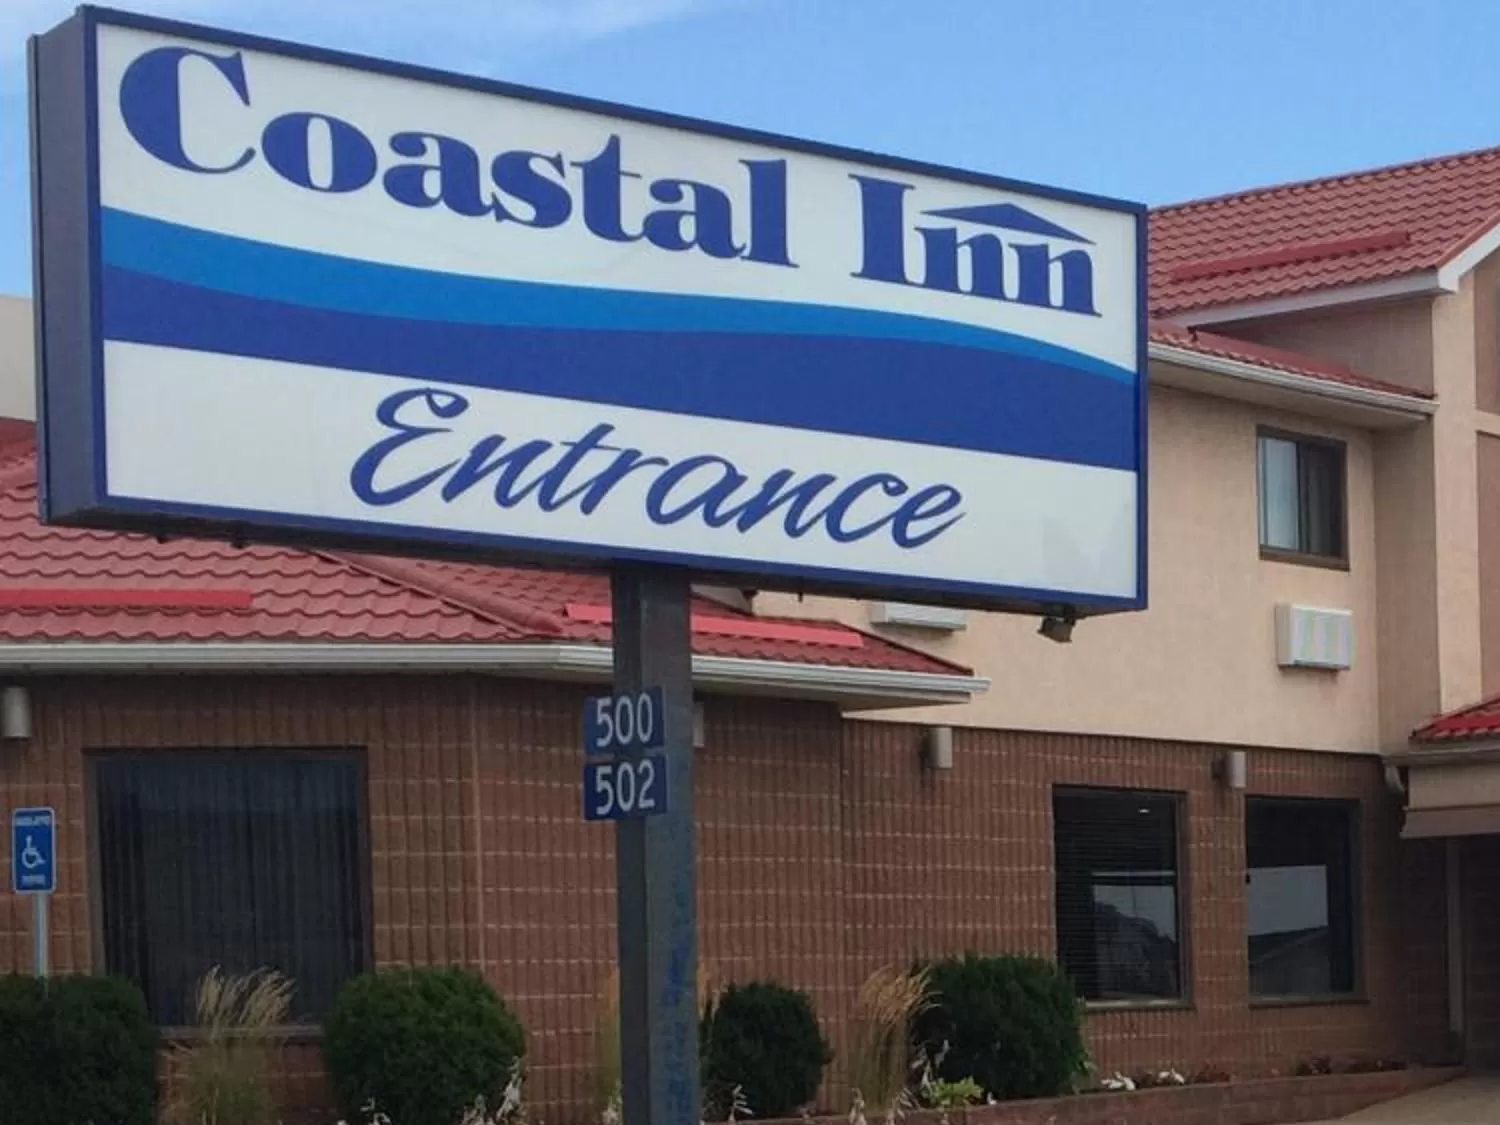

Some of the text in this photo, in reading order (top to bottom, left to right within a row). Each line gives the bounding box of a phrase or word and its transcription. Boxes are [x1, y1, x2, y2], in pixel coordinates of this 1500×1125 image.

[119, 45, 1103, 318] Coastal Inn
[350, 386, 965, 549] Entrance
[596, 692, 653, 747] 500
[596, 758, 655, 816] 502
